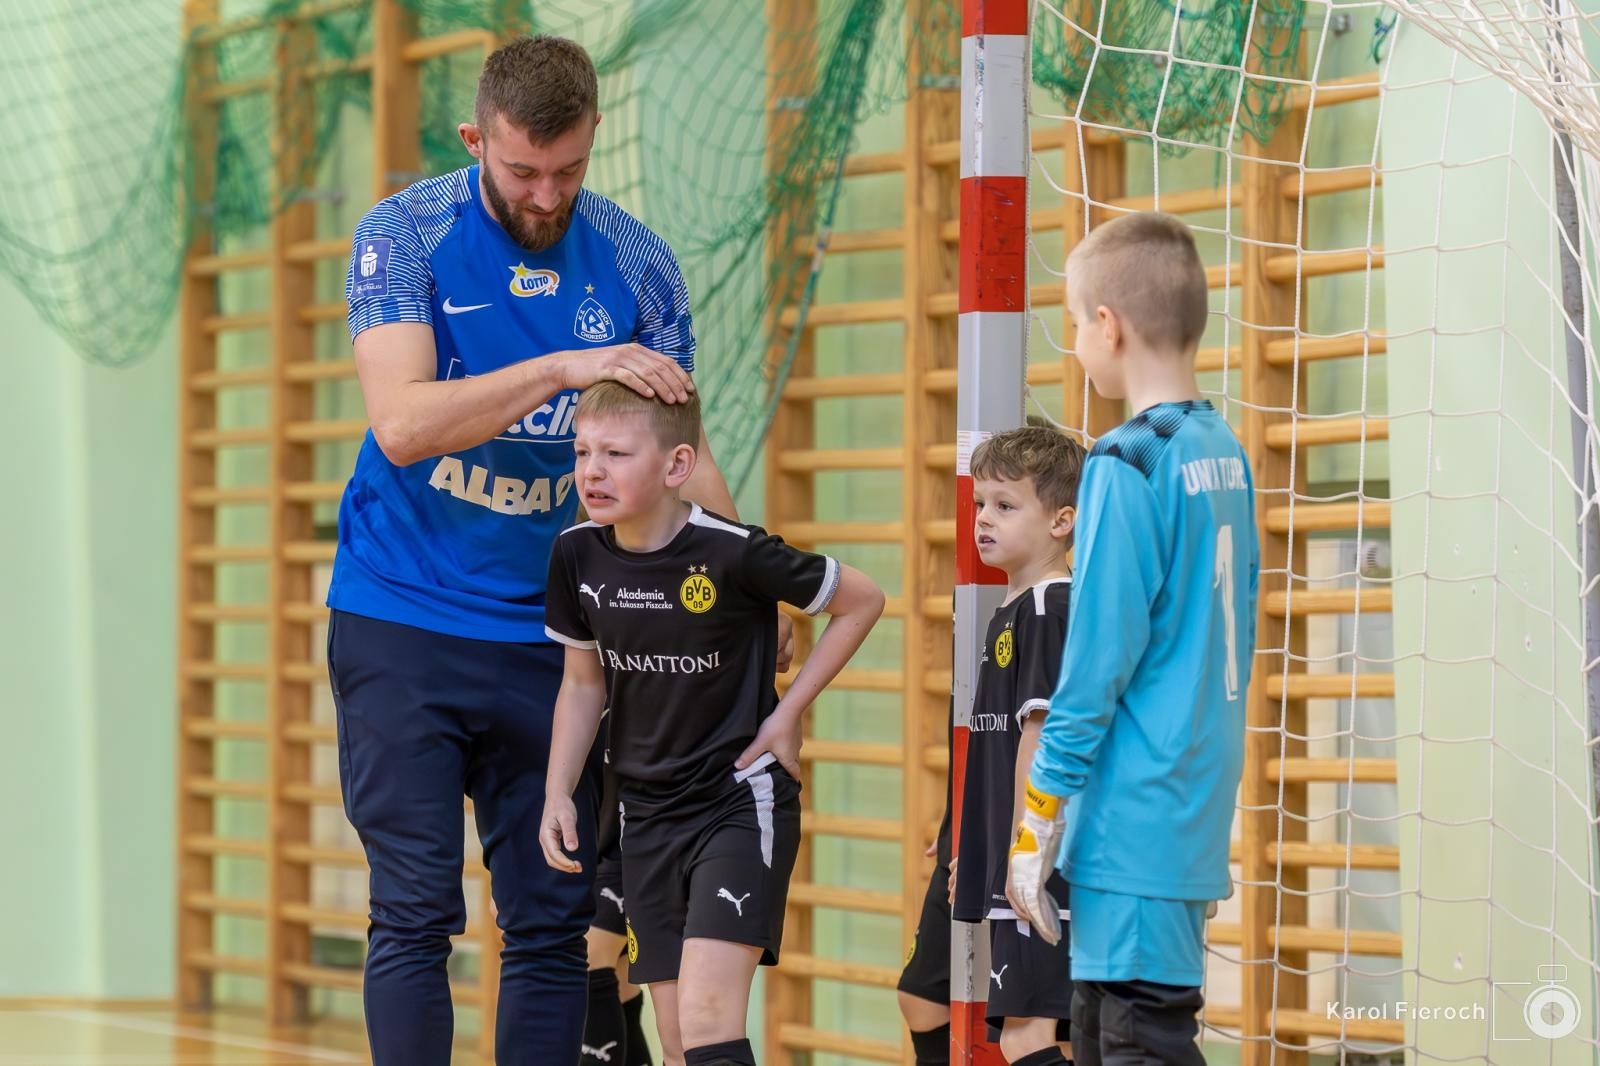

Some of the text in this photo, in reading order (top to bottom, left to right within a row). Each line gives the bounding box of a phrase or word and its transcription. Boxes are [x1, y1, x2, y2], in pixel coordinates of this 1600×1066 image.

[519, 275, 549, 291] LOTTO
[597, 308, 611, 326] RUCH
[428, 455, 551, 516] ALBA
[616, 587, 665, 601] Akademia
[685, 578, 712, 601] BVB
[609, 600, 673, 610] im. Łukasza Piszczka
[692, 601, 704, 609] 09
[1213, 524, 1240, 701] 1
[605, 650, 720, 674] PANATTONI
